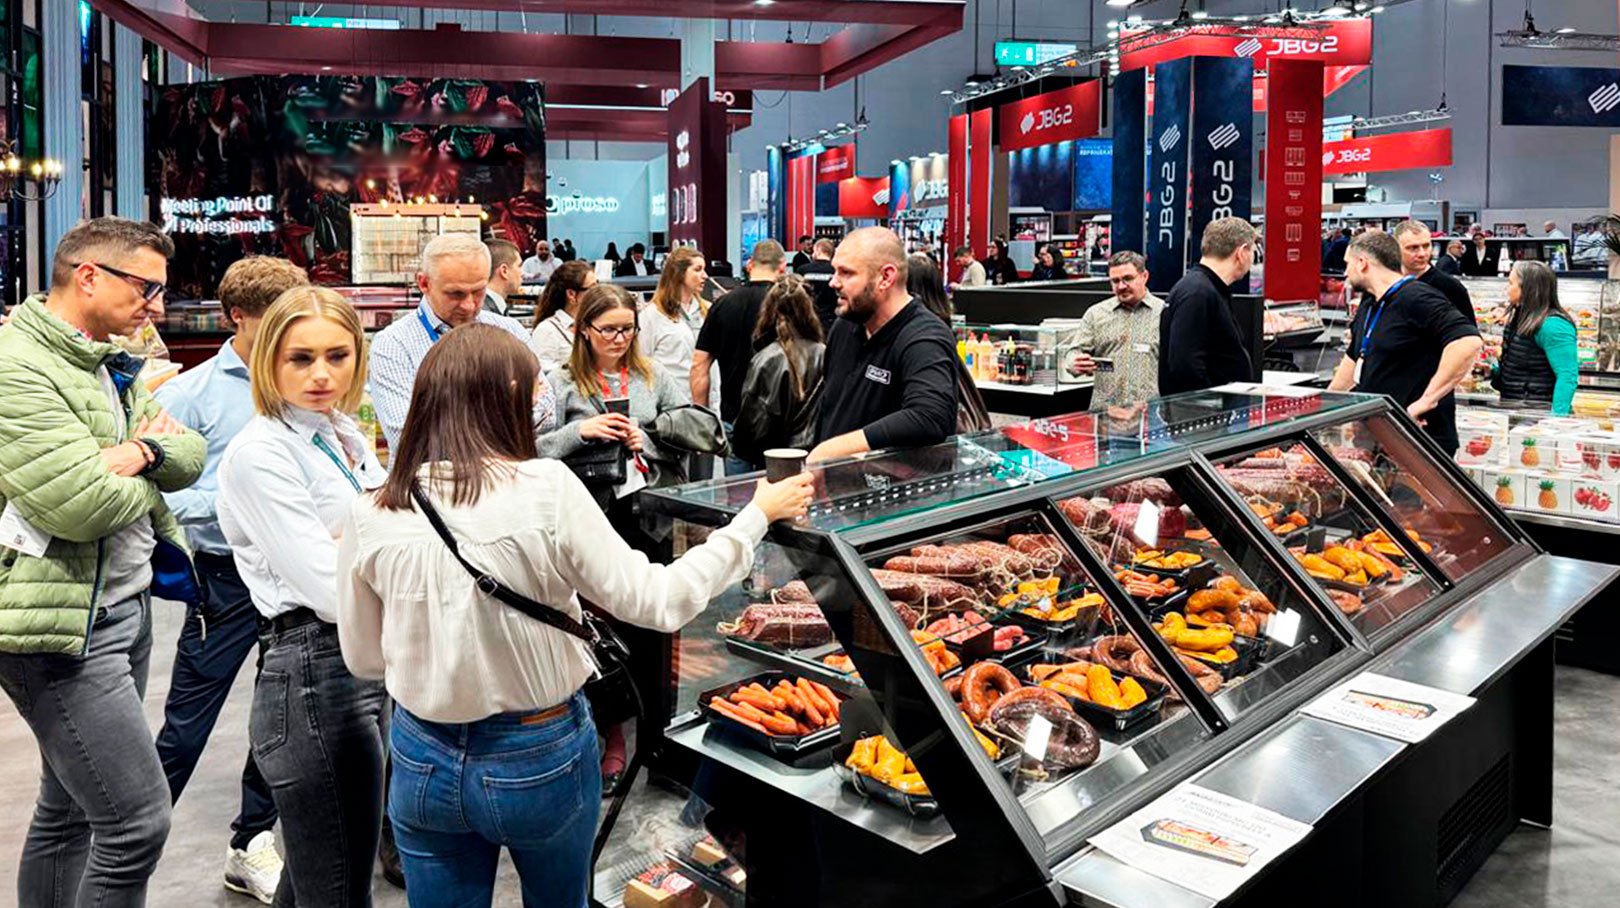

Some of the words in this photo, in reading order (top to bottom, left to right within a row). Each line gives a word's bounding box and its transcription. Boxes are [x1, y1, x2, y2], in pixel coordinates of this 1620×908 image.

[1266, 36, 1338, 55] JBG2
[1036, 104, 1073, 130] JBG2
[1336, 148, 1371, 163] JBG2
[1212, 160, 1234, 221] BG2
[215, 196, 254, 213] Point
[254, 194, 274, 212] Of
[1159, 161, 1176, 249] JBG2
[180, 215, 275, 234] Professionals
